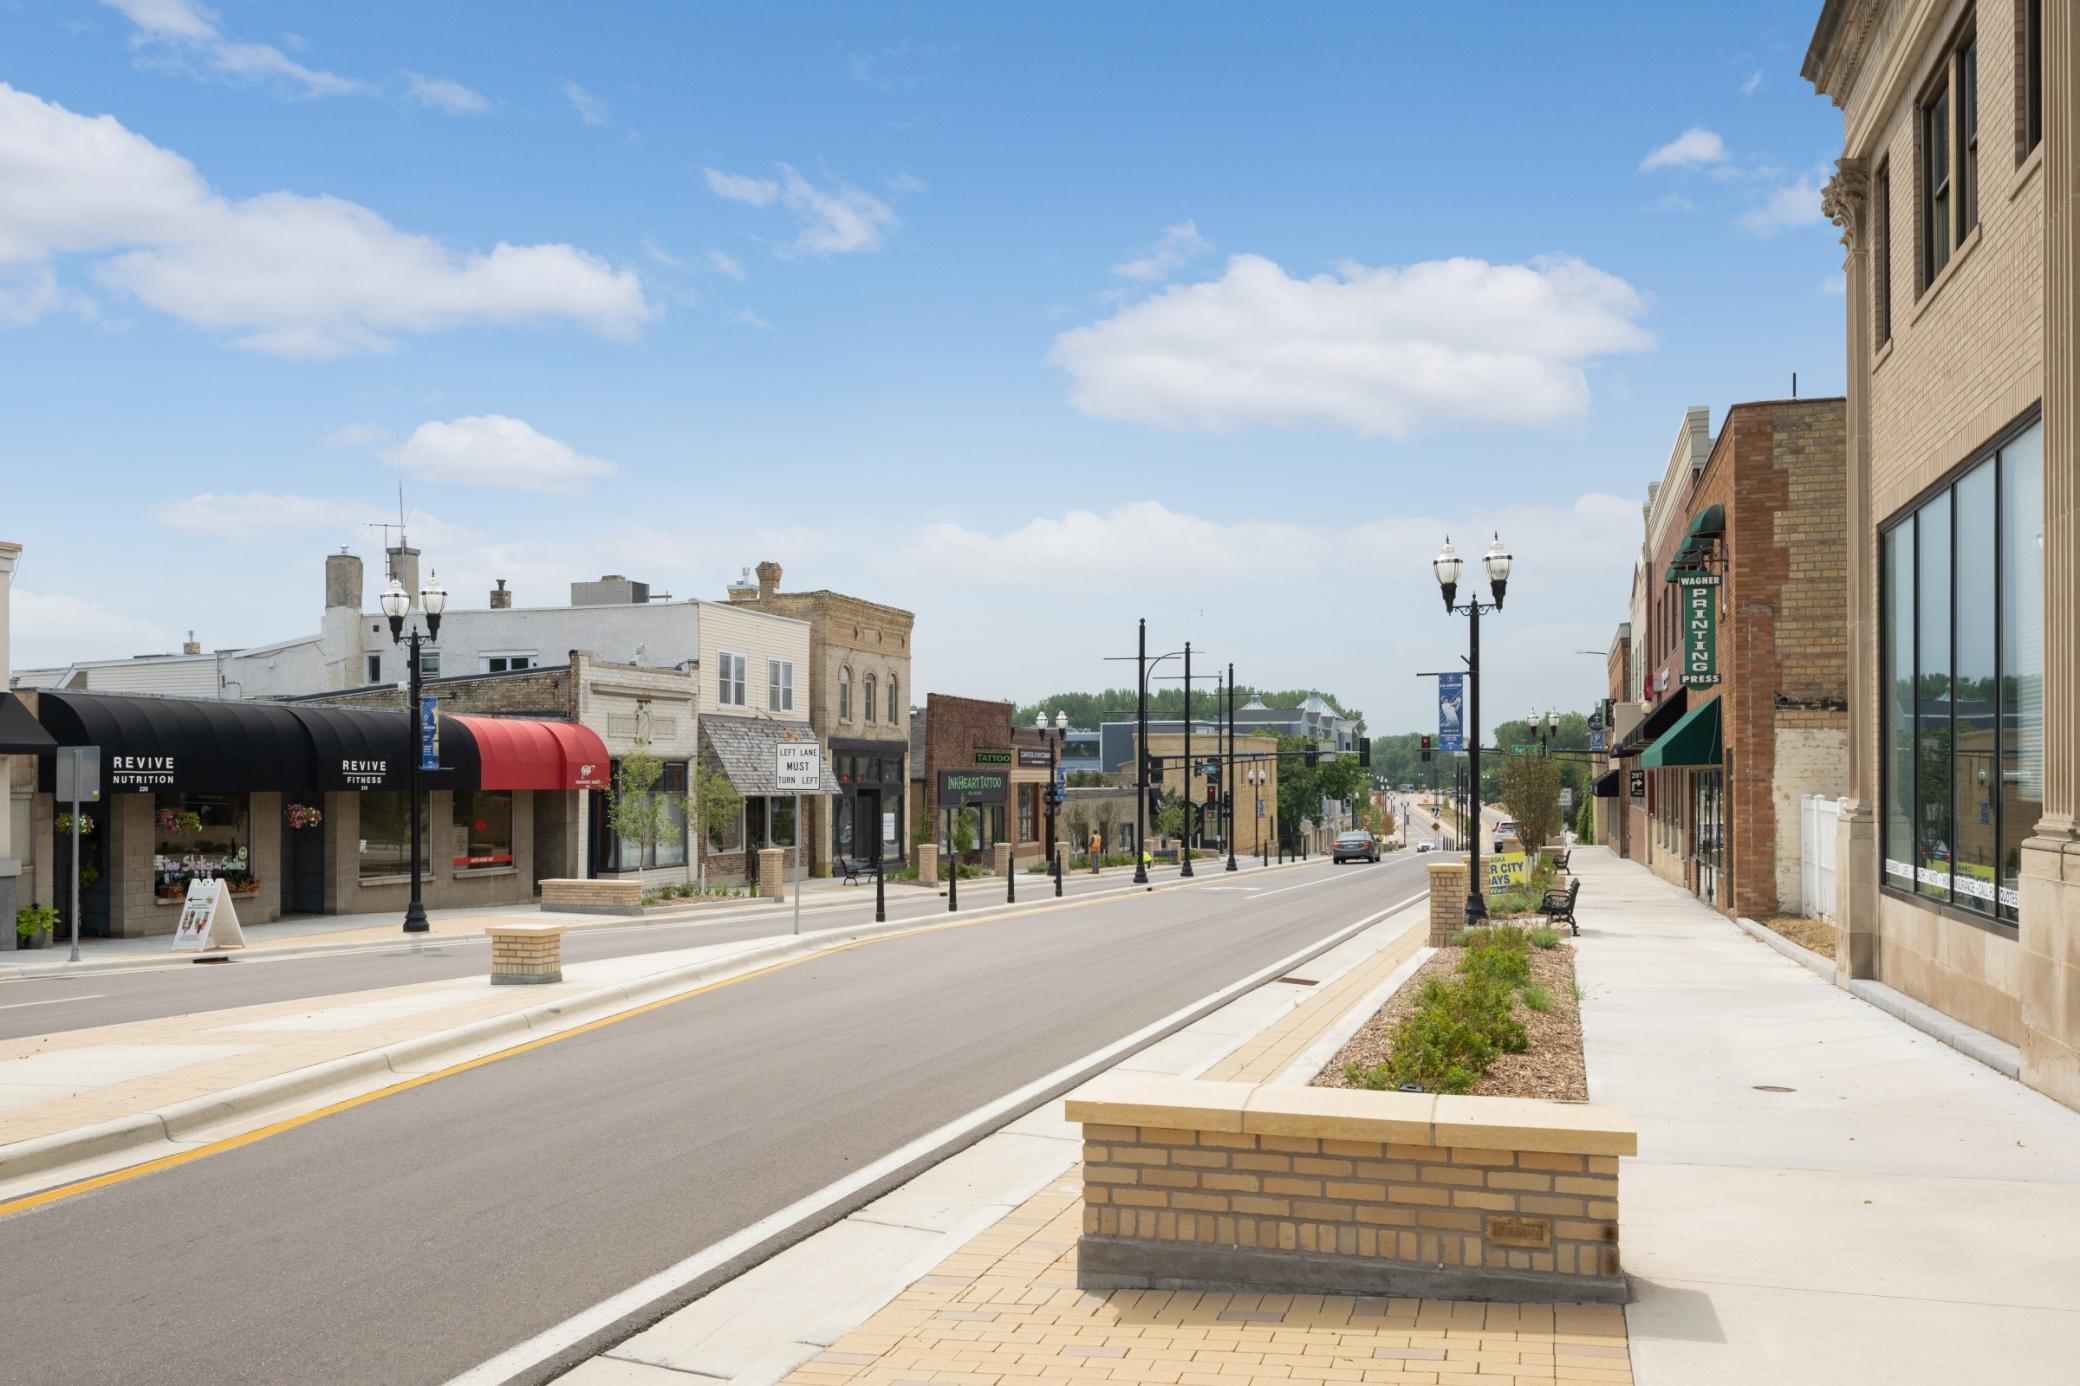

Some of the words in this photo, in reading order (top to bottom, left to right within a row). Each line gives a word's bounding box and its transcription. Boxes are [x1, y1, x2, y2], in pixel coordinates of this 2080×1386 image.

[1681, 577, 1720, 585] WAGNER
[1692, 588, 1709, 672] PRINTING
[1682, 675, 1720, 683] PRESS
[779, 749, 796, 757] LEFT
[800, 749, 817, 757] LANE
[113, 756, 174, 769] REVIVE
[977, 753, 1010, 763] TATTOO
[342, 760, 387, 771] REVIVE
[786, 761, 809, 771] MUST
[113, 775, 174, 784] NUTRITION
[347, 776, 382, 784] FITNESS
[778, 776, 796, 784] TURN
[801, 776, 818, 785] LEFT
[1500, 862, 1524, 873] CITY
